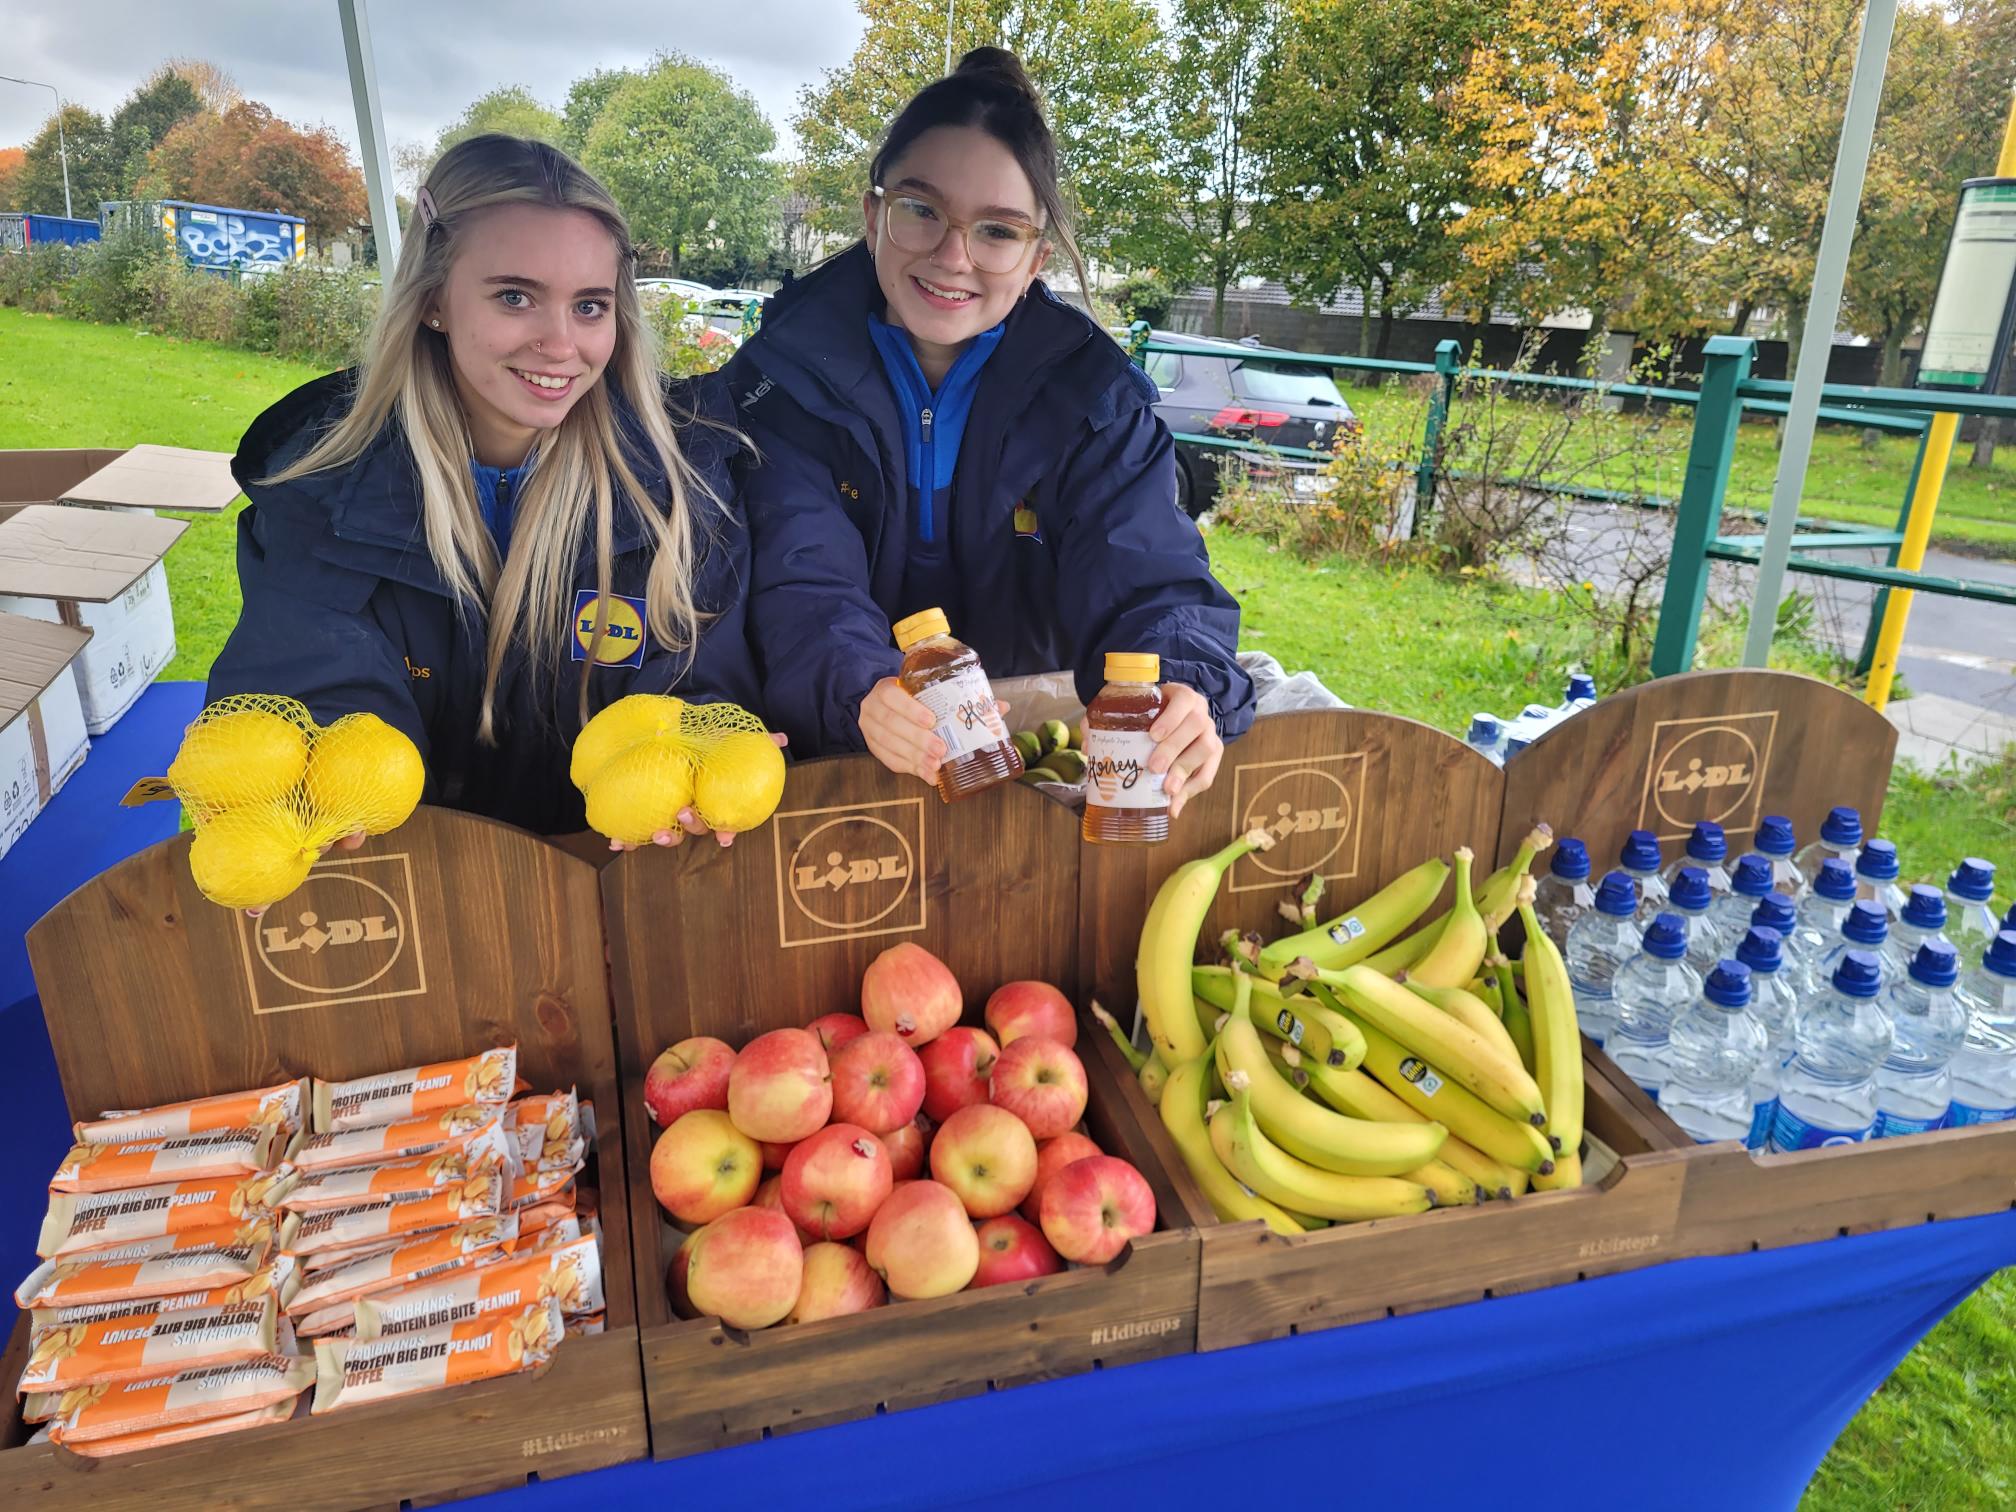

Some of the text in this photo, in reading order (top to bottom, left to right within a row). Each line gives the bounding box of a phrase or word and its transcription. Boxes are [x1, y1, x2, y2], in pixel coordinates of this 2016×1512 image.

[579, 618, 639, 641] LDL
[1088, 754, 1144, 789] Honey
[330, 1074, 453, 1110] PROTEIN BIG BITE PEANUT
[162, 1138, 190, 1150] BITE
[189, 1136, 212, 1148] BIG
[73, 1203, 118, 1225] PROTEIN
[119, 1200, 143, 1215] BIG
[142, 1196, 172, 1212] BITE
[168, 1190, 217, 1207] PEANUT
[301, 1207, 349, 1226] PROTEIN
[160, 1291, 210, 1312] PEANUT
[222, 1300, 266, 1315] TOFFEE
[381, 1289, 522, 1336] PROTEIN BIG BITE PEANUT
[99, 1311, 263, 1346] PROTEIN BIG BITE PEANUT
[344, 1331, 493, 1374] PROTEIN BIG BITE PEANUT
[123, 1375, 179, 1394] PEANUT
